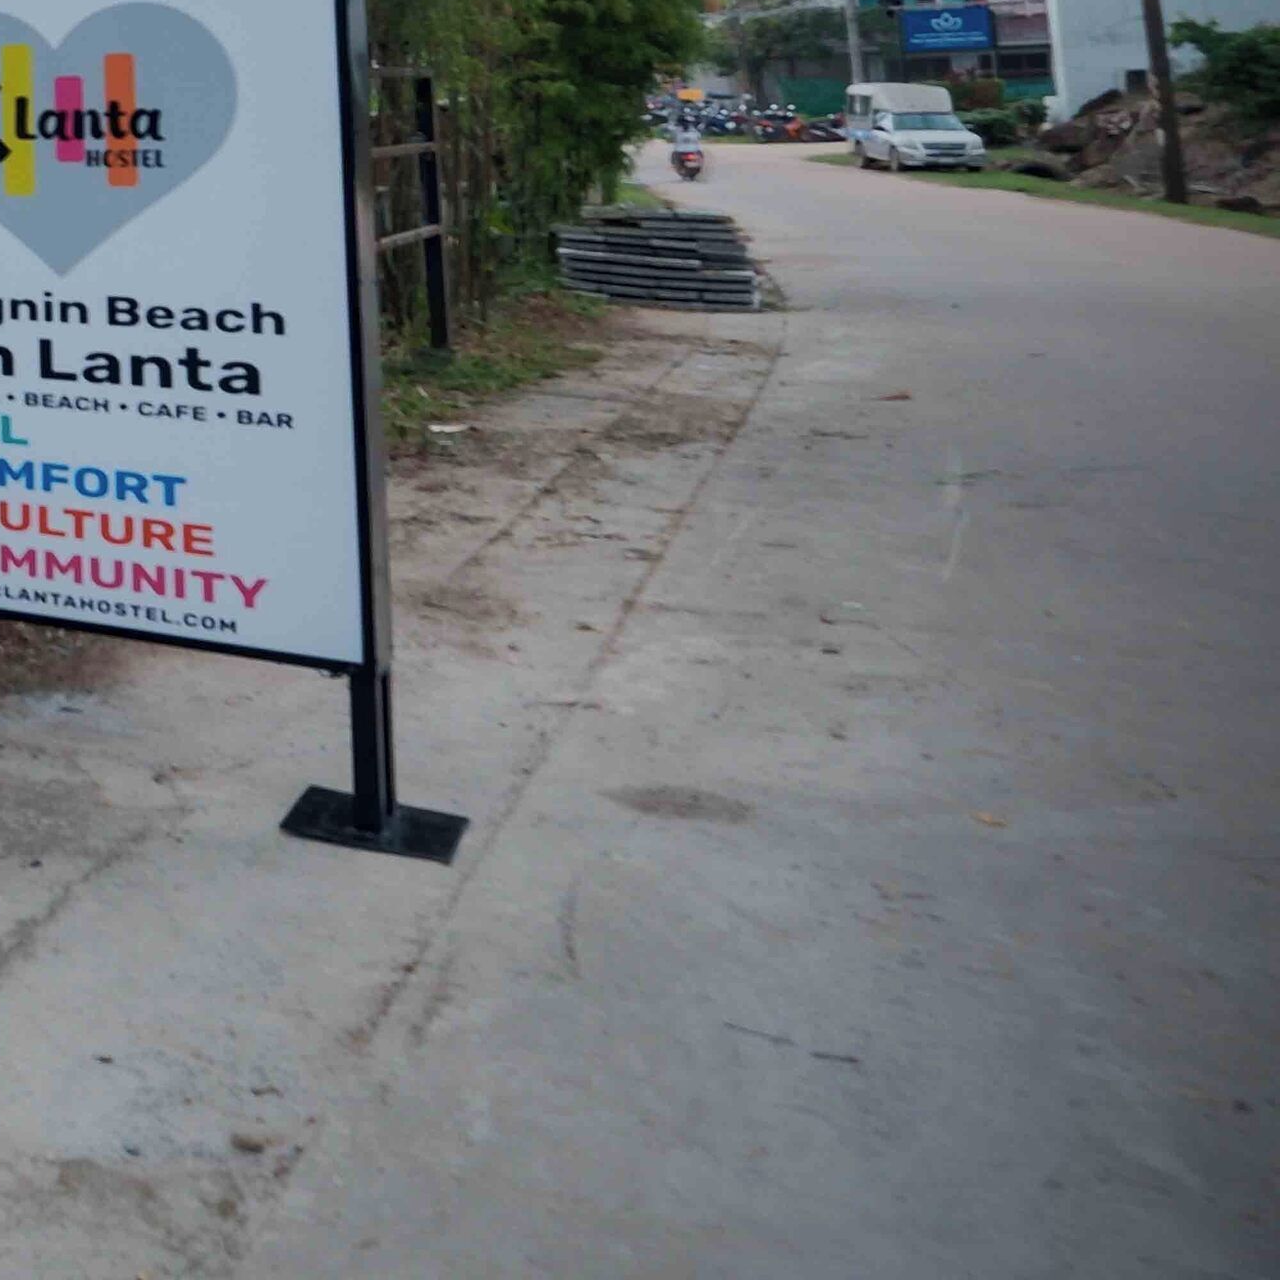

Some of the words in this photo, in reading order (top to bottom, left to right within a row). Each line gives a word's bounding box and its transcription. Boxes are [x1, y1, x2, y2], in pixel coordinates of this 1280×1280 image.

[86, 148, 166, 169] HOSTEL
[106, 295, 287, 336] Beach
[38, 338, 263, 397] Lanta
[23, 391, 111, 413] BEACH
[137, 400, 208, 422] CAFE
[236, 408, 296, 429] BAR
